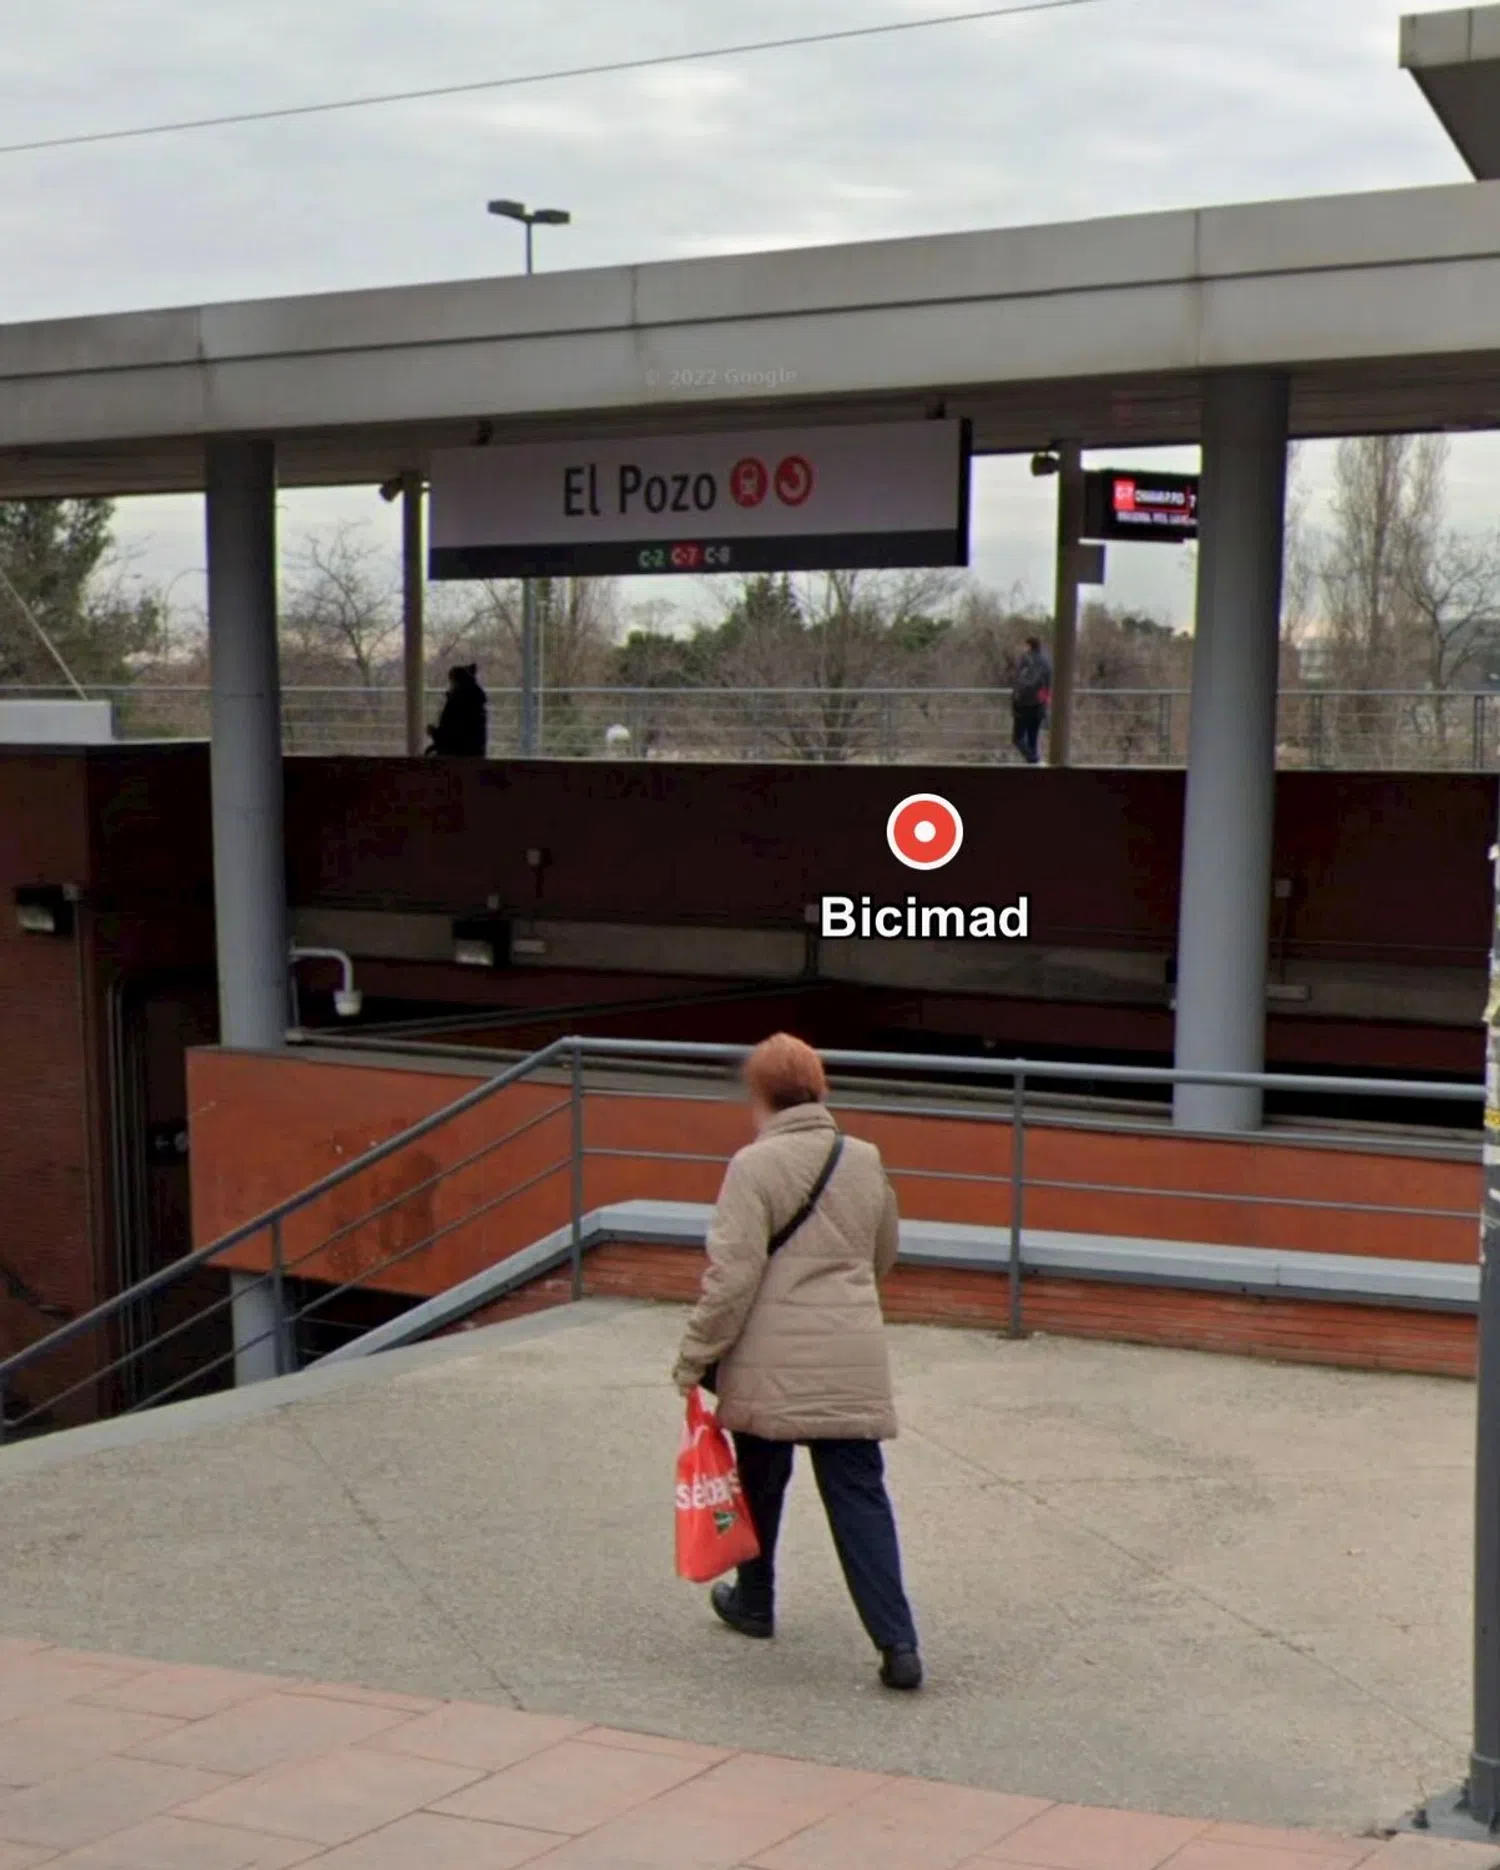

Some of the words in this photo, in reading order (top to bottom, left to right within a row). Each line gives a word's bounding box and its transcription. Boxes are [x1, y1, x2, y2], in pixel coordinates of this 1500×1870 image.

[563, 464, 600, 517] El
[619, 464, 717, 514] Pozo
[638, 549, 665, 568] C-2
[671, 546, 699, 566] C-7
